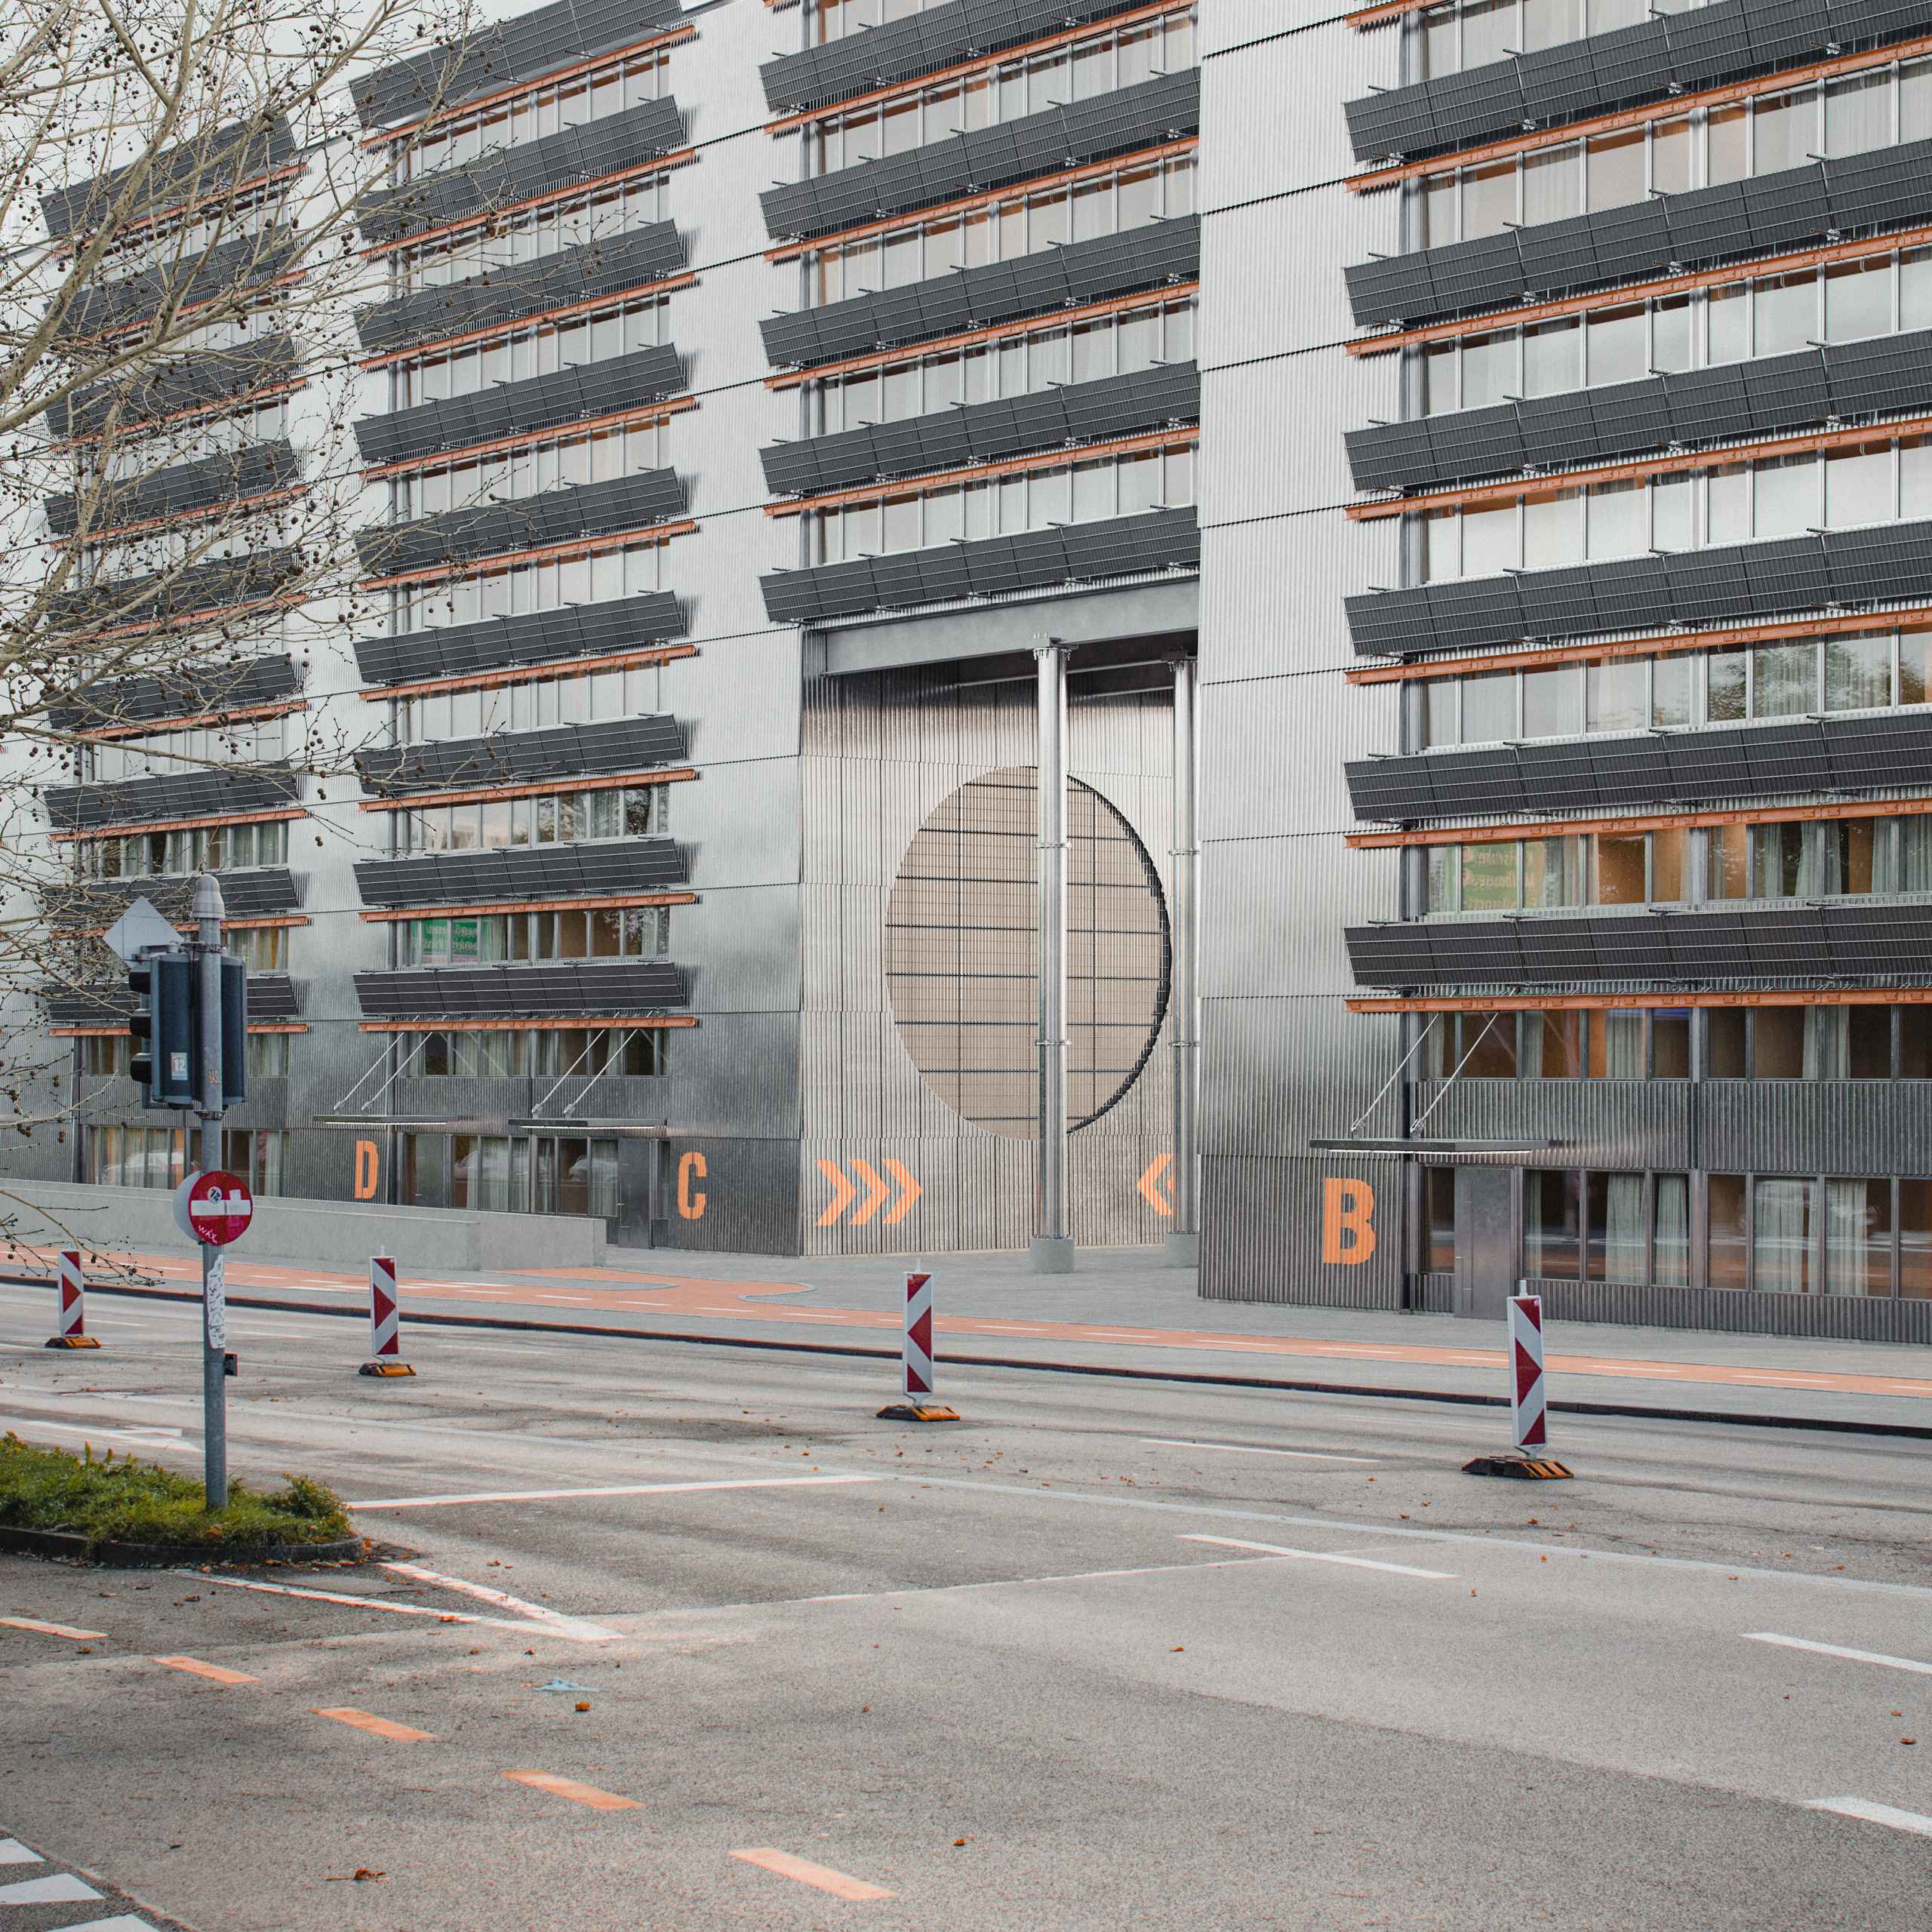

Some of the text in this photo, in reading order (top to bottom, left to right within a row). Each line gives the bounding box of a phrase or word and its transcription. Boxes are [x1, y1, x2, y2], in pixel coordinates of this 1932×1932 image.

[174, 1057, 187, 1072] 12
[355, 1140, 378, 1198] D
[678, 1152, 707, 1220] C
[1324, 1177, 1377, 1264] B
